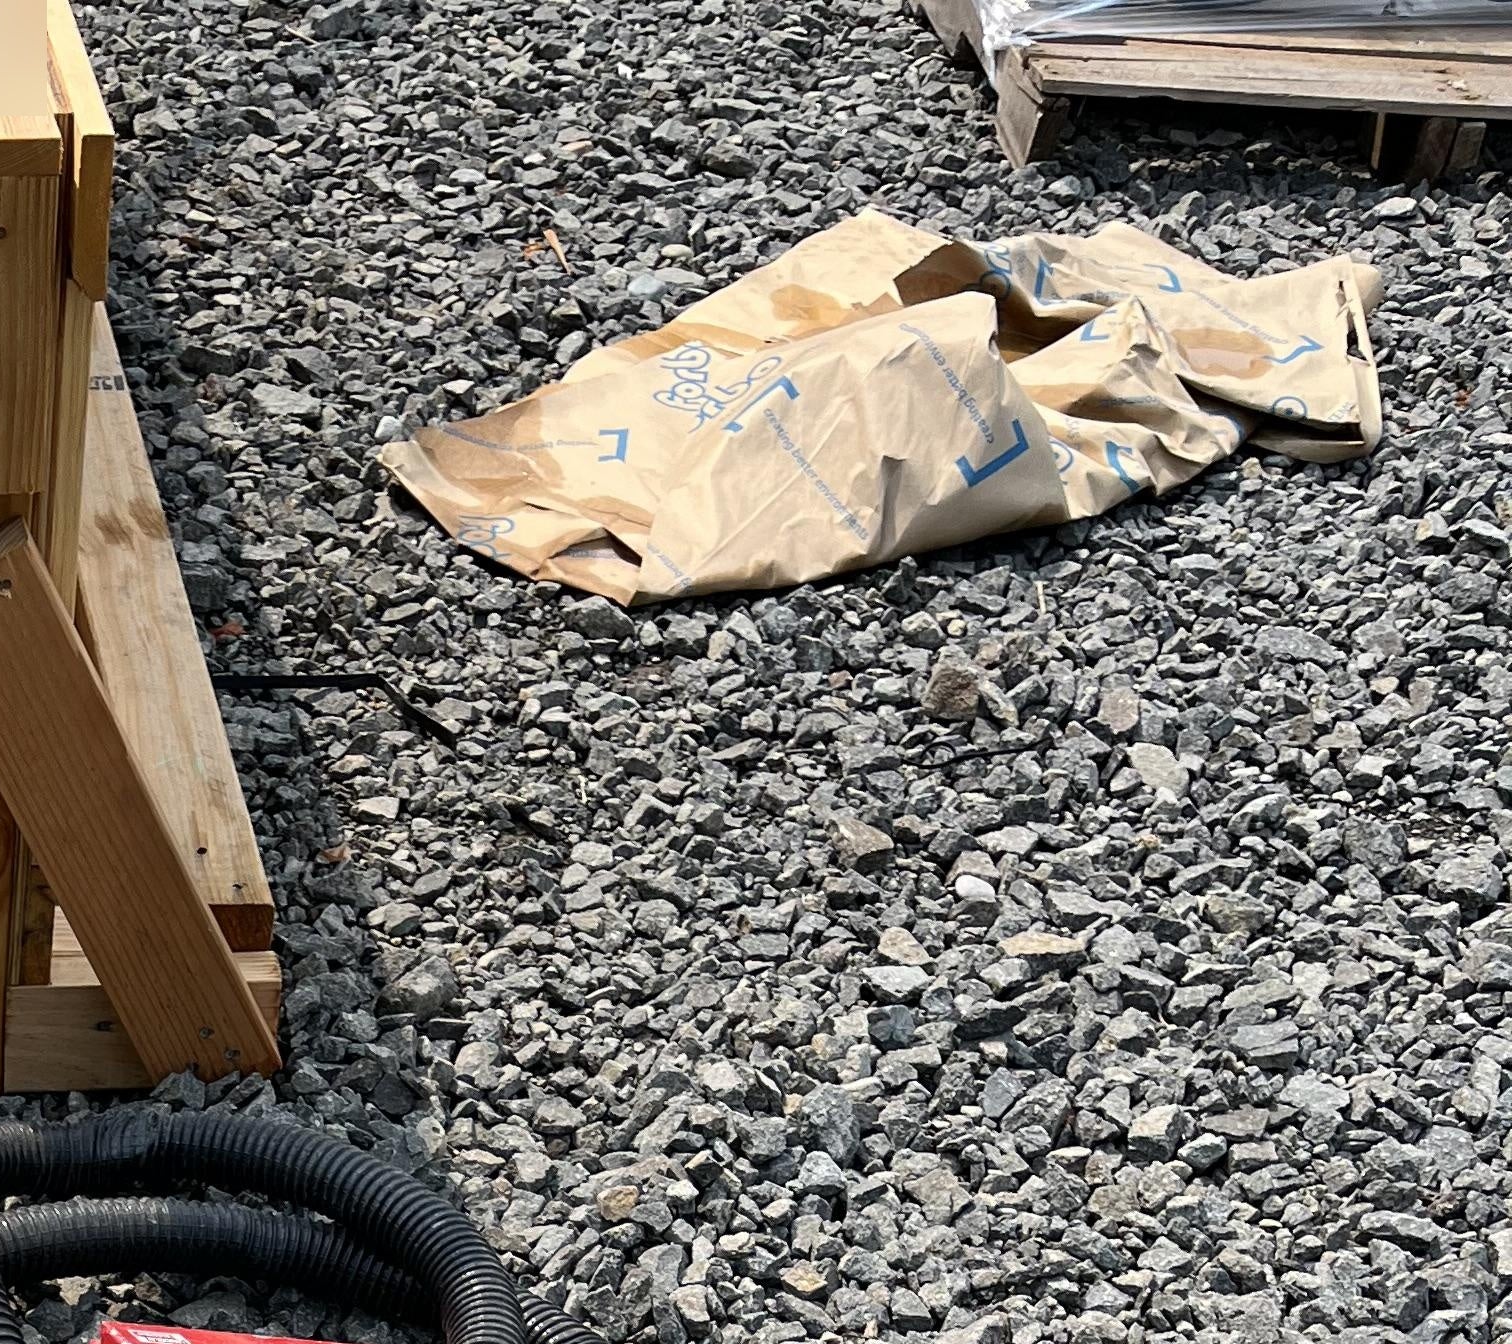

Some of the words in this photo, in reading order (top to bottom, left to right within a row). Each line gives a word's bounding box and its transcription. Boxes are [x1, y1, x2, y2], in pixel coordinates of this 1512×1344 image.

[942, 367, 968, 408] better
[763, 408, 794, 451] creating
[791, 448, 817, 479] better
[964, 397, 995, 446] creating
